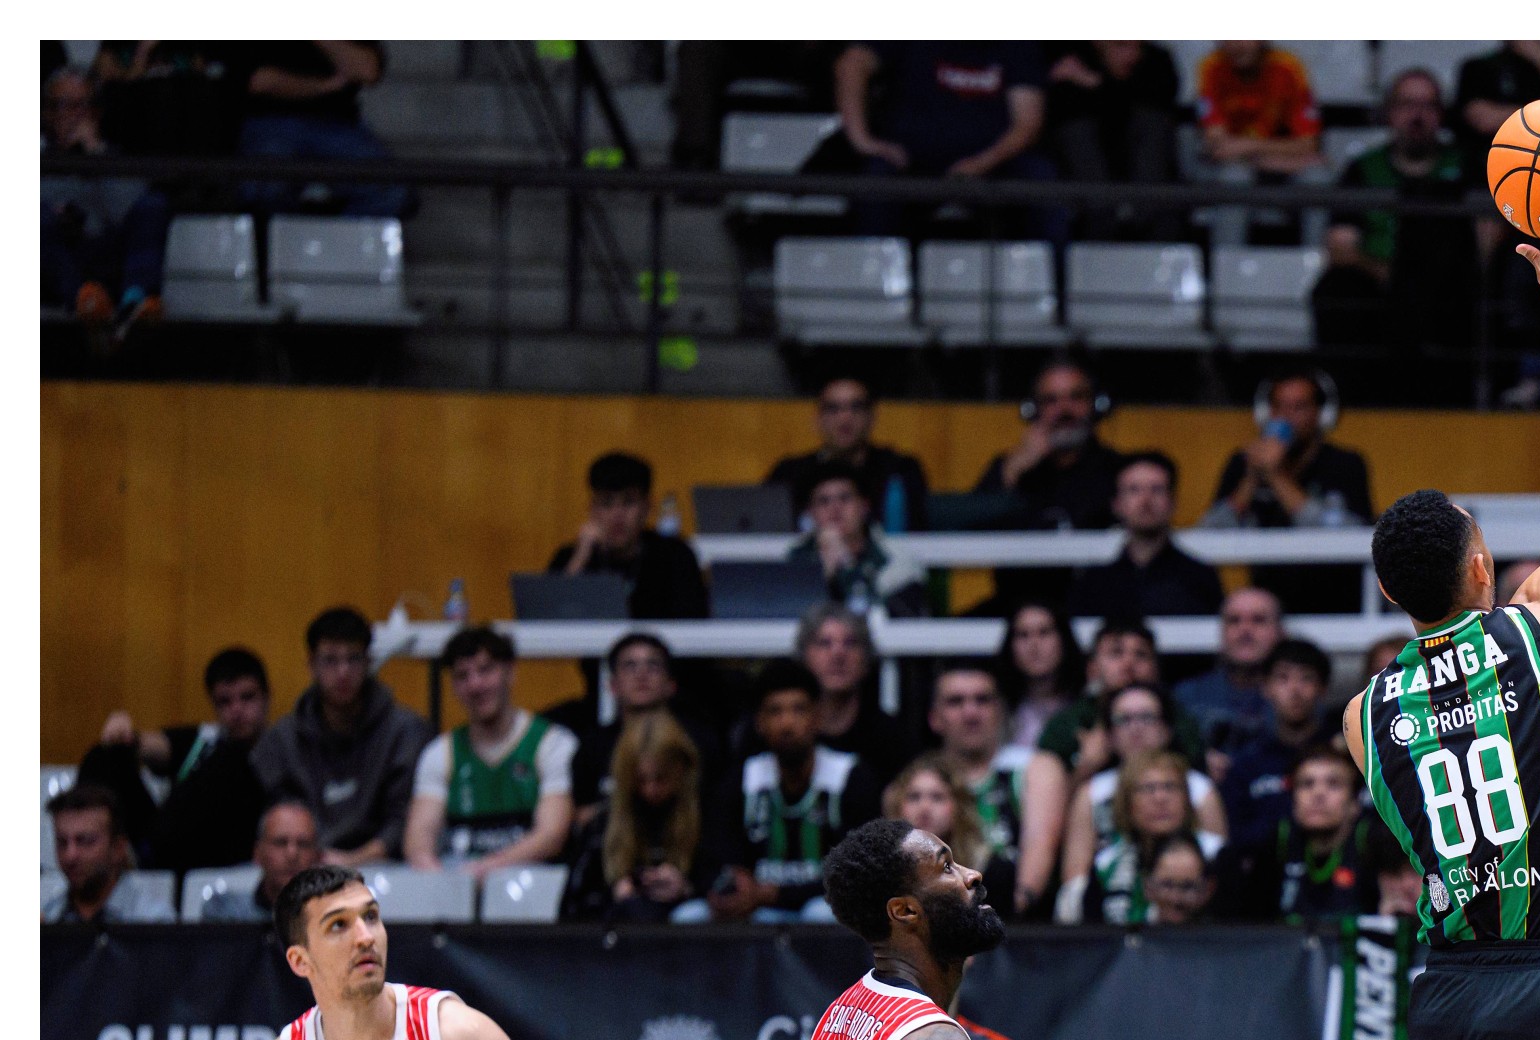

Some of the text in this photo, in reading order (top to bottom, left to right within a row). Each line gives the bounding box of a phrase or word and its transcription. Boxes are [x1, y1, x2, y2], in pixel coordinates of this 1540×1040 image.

[1382, 633, 1509, 703] HANGA
[1426, 690, 1519, 737] PROBITAS
[1416, 734, 1530, 859] 88
[1448, 856, 1499, 885] City of
